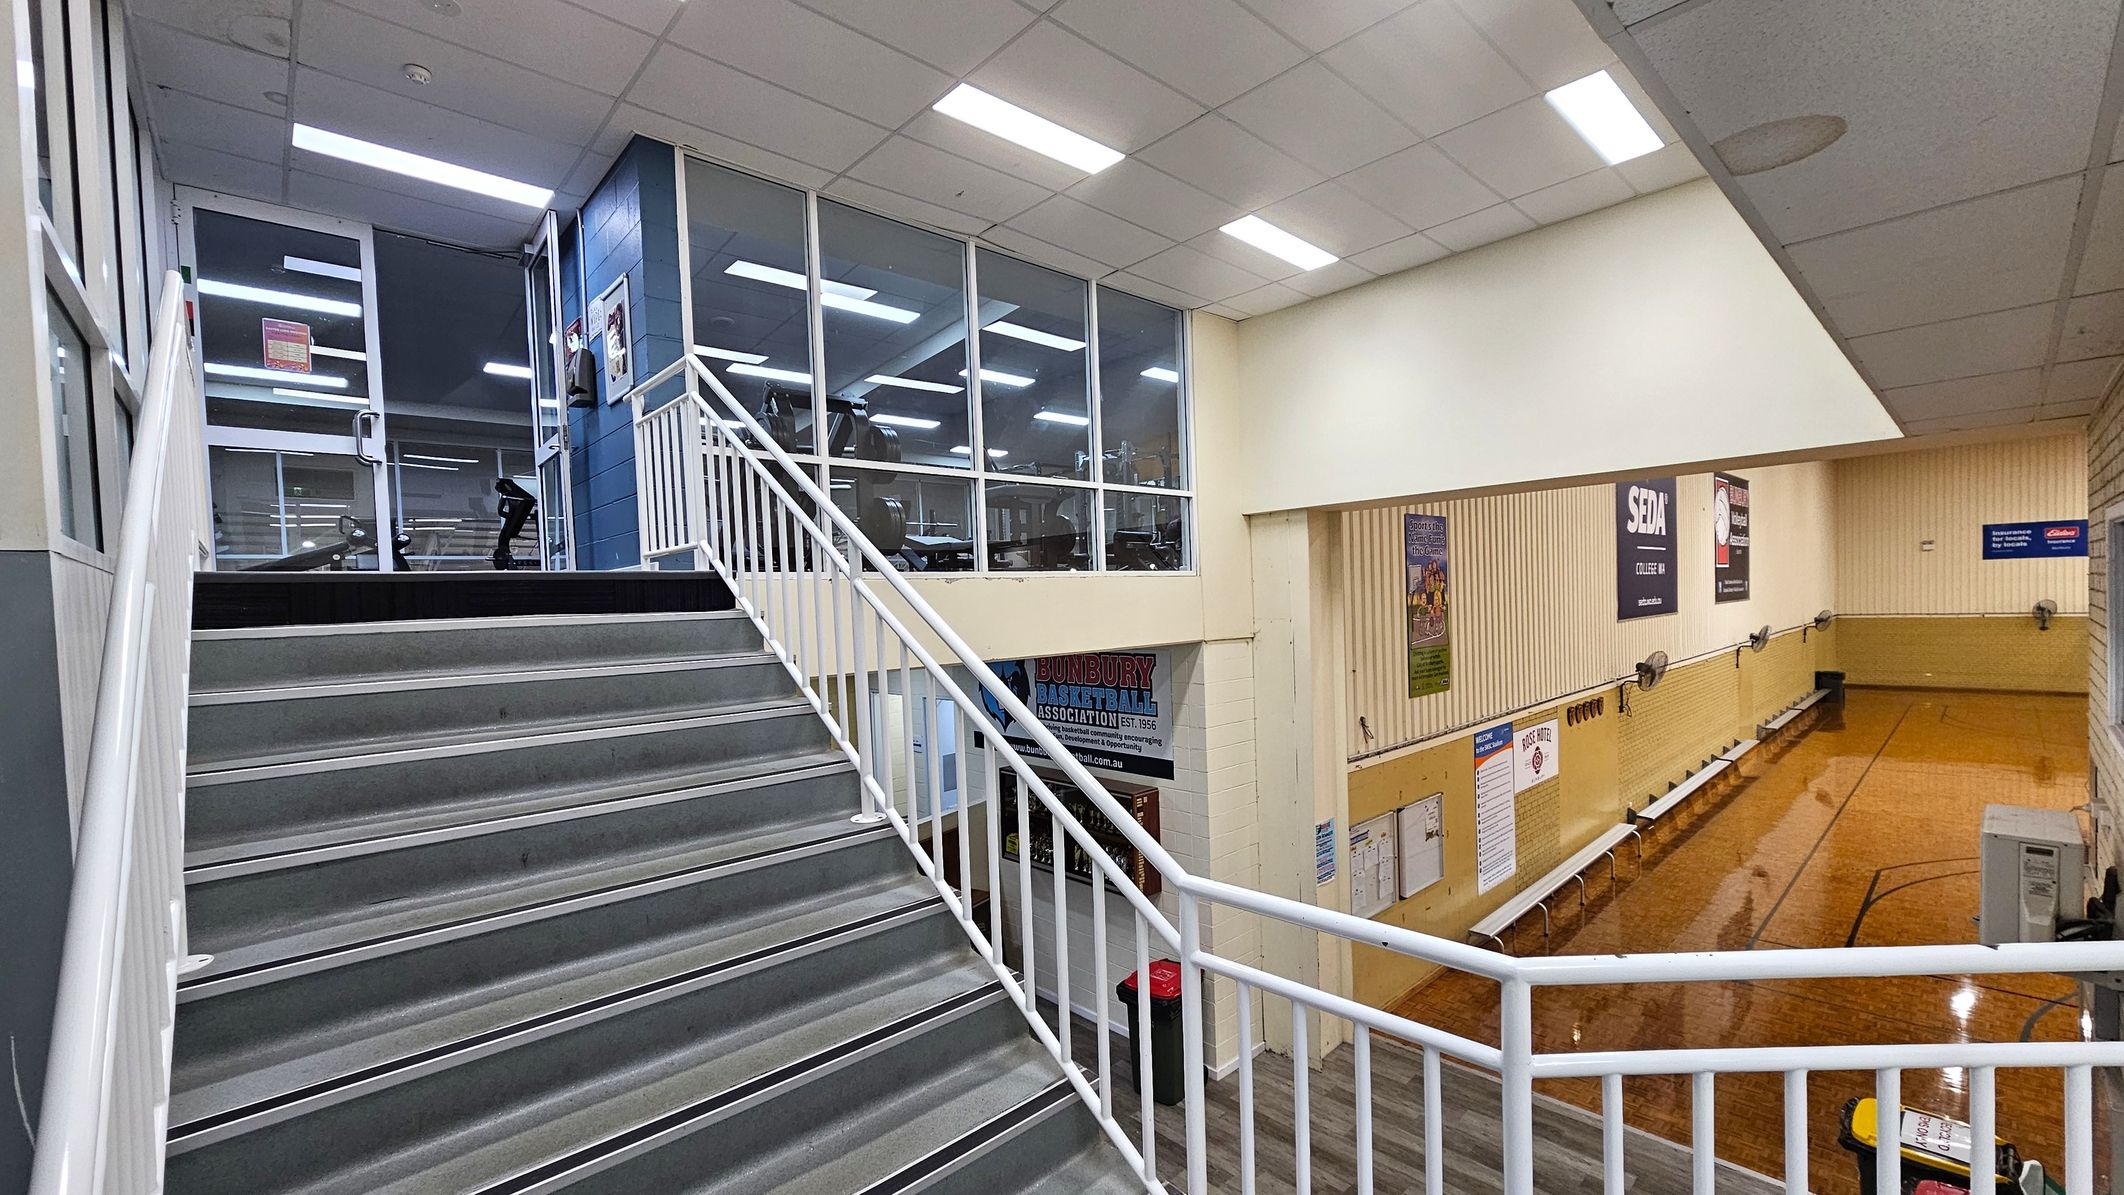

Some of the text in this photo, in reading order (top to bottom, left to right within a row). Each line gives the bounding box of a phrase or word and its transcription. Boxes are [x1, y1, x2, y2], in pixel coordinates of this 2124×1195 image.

[1627, 485, 1666, 535] SEDA
[1433, 521, 1443, 532] the
[1408, 532, 1428, 543] Name
[1412, 545, 1443, 556] the Game
[1636, 562, 1657, 575] COLLEGE
[1036, 654, 1155, 689] BUNBURY
[1036, 683, 1158, 715] BASKETBALL
[1037, 705, 1157, 730] ASSOCIATION EST. 1956
[1062, 725, 1090, 735] basketball
[1091, 729, 1123, 741] community
[1124, 734, 1163, 747] encouraging
[1065, 734, 1101, 744] Development
[1106, 740, 1142, 752] Opportunity
[1475, 732, 1493, 744] WELCOME
[1521, 727, 1552, 752] ROSE HOTEL
